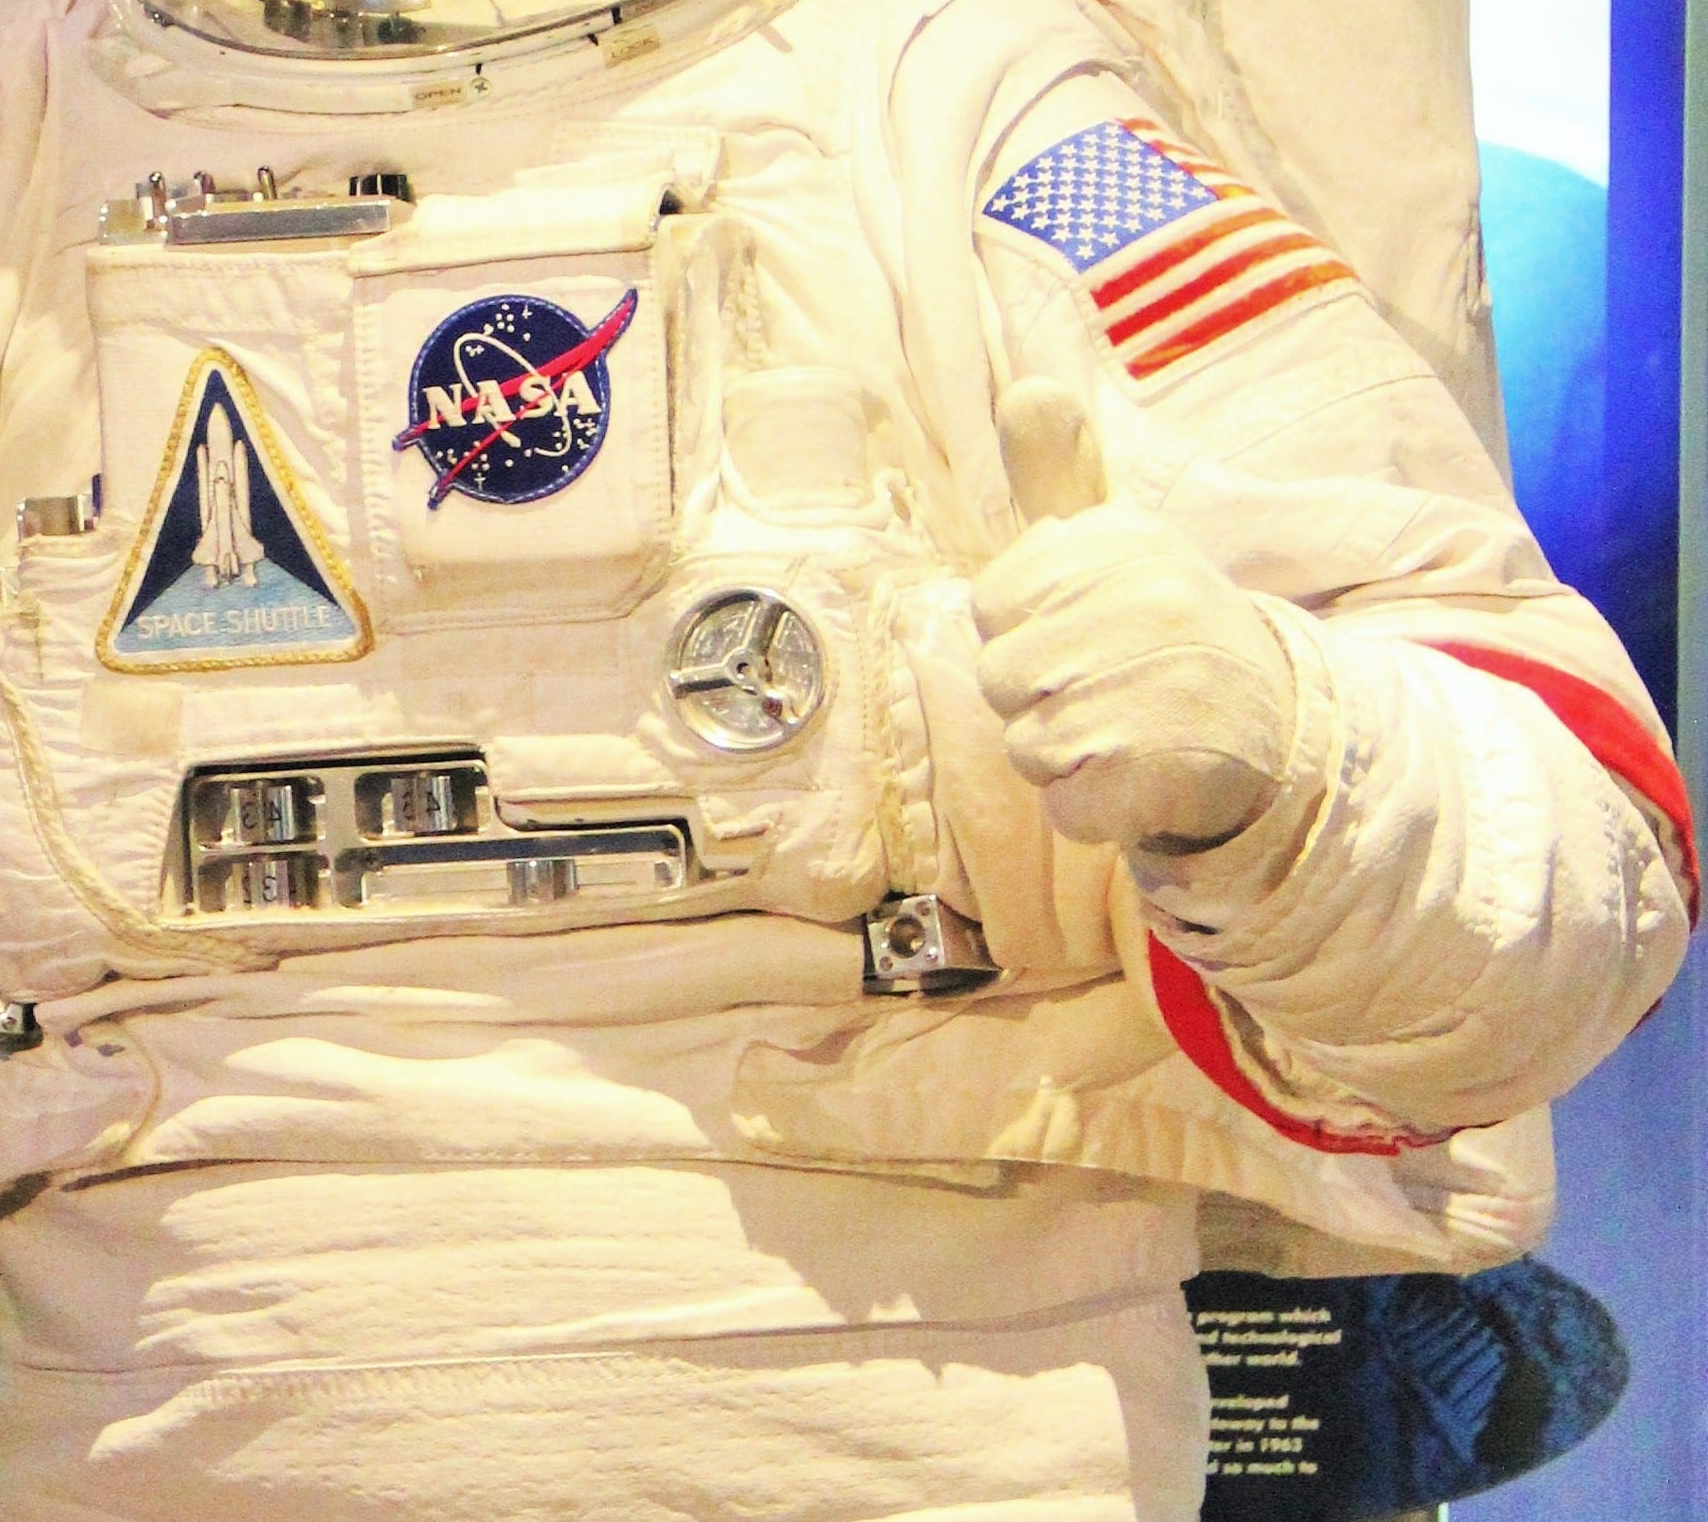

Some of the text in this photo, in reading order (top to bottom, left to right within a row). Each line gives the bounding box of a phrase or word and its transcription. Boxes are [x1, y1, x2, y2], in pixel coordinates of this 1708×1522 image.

[422, 370, 602, 429] NASA
[137, 604, 332, 640] SPACE SHUTTLE
[1196, 1311, 1275, 1327] program
[1221, 1329, 1342, 1348] technological
